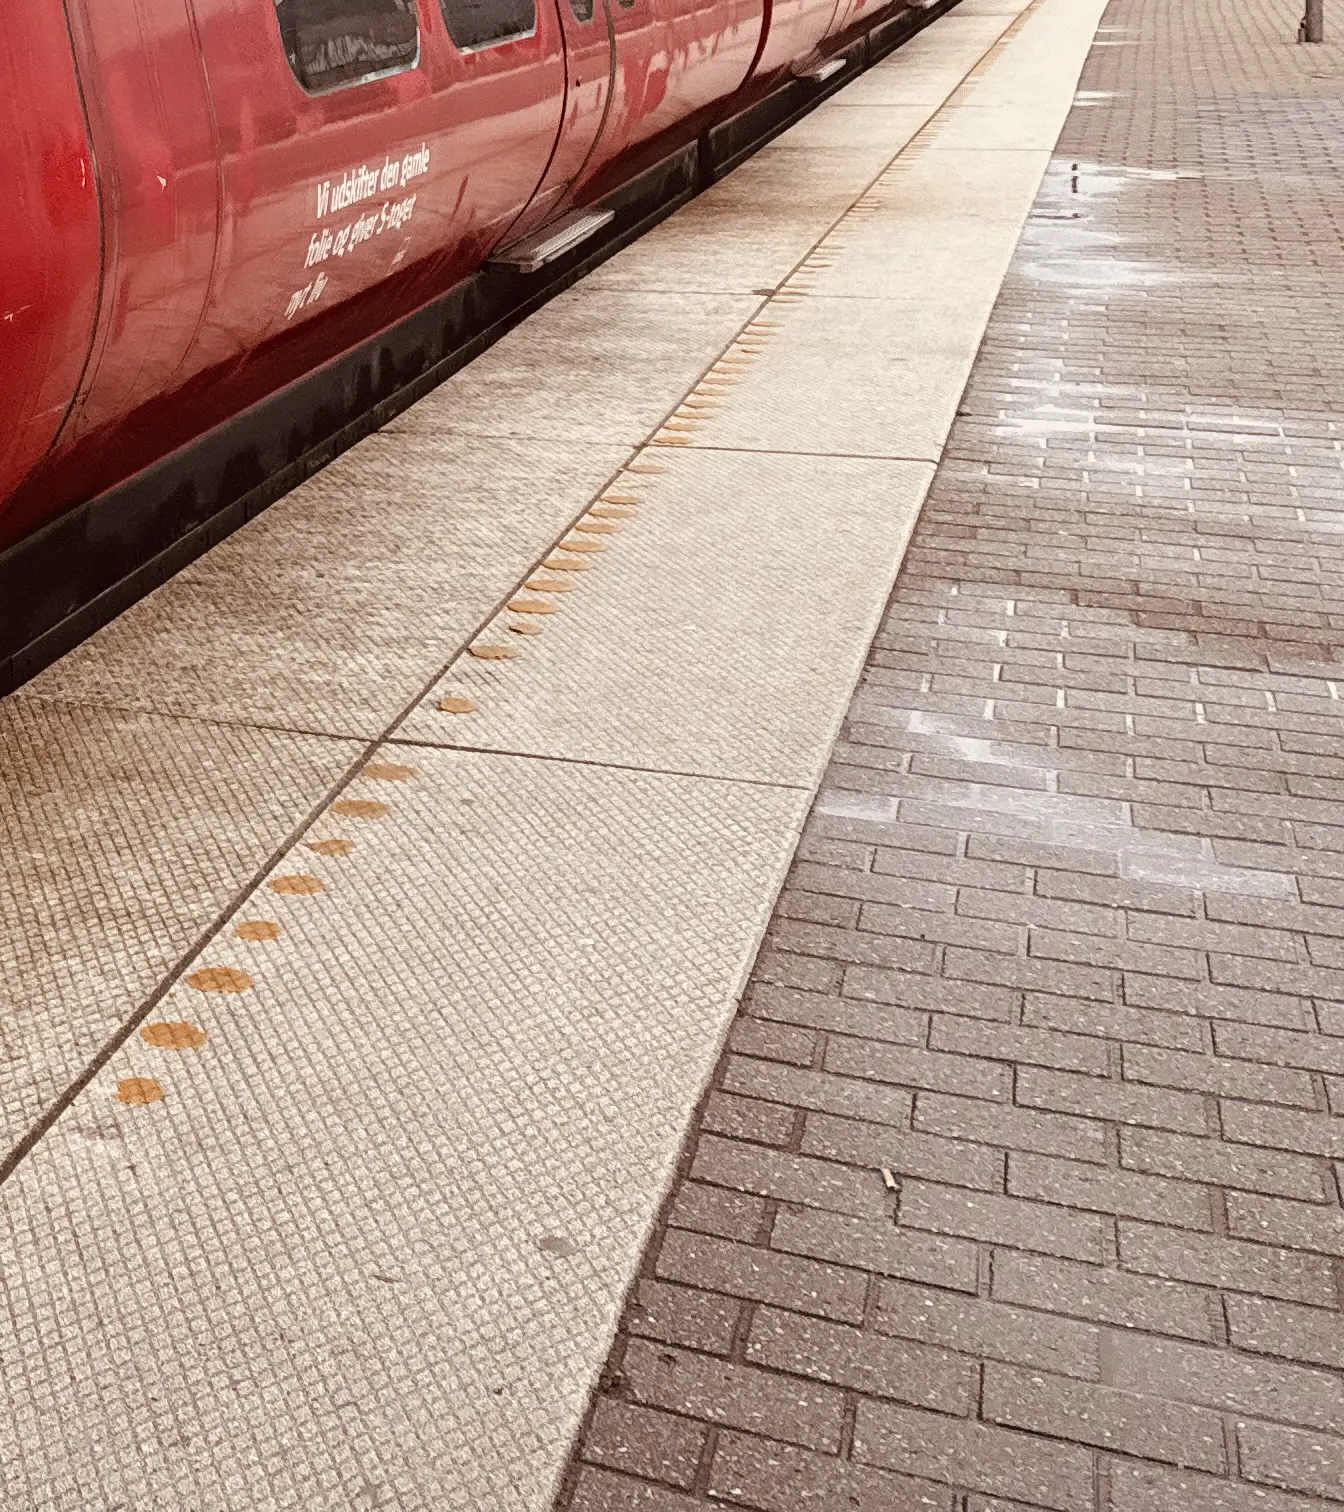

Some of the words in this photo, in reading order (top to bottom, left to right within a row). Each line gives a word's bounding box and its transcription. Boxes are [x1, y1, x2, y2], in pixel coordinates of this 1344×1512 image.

[316, 181, 330, 219] Vi
[330, 165, 380, 213] udskifter
[380, 156, 400, 191] den
[400, 142, 430, 187] gamle
[304, 228, 333, 269] folie
[332, 223, 352, 258] og
[347, 212, 379, 253] giver
[376, 193, 417, 235] S-toget
[283, 282, 313, 321] nyt
[306, 271, 329, 305] liv
